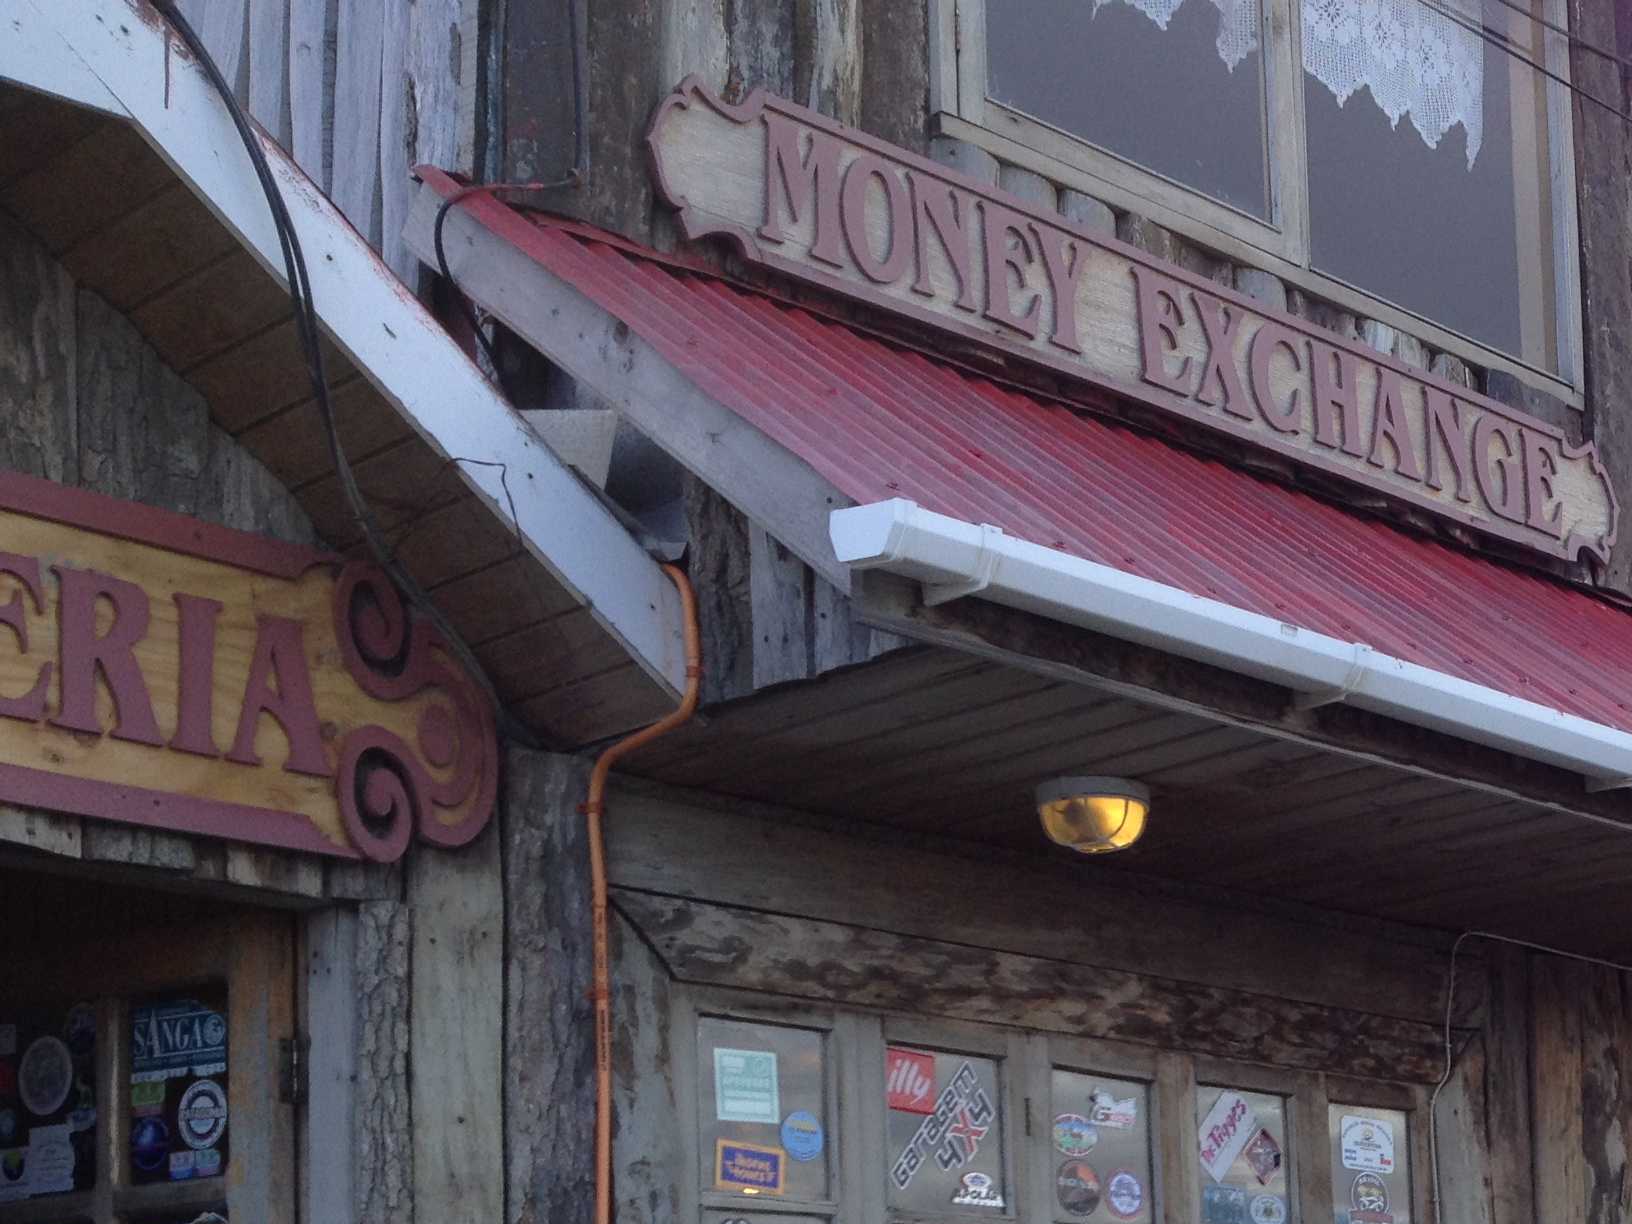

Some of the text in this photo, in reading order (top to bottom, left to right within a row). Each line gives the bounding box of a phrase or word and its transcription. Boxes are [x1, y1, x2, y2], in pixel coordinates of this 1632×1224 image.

[760, 116, 1563, 537] MONEY EXCHANGE
[888, 1059, 931, 1105] illy
